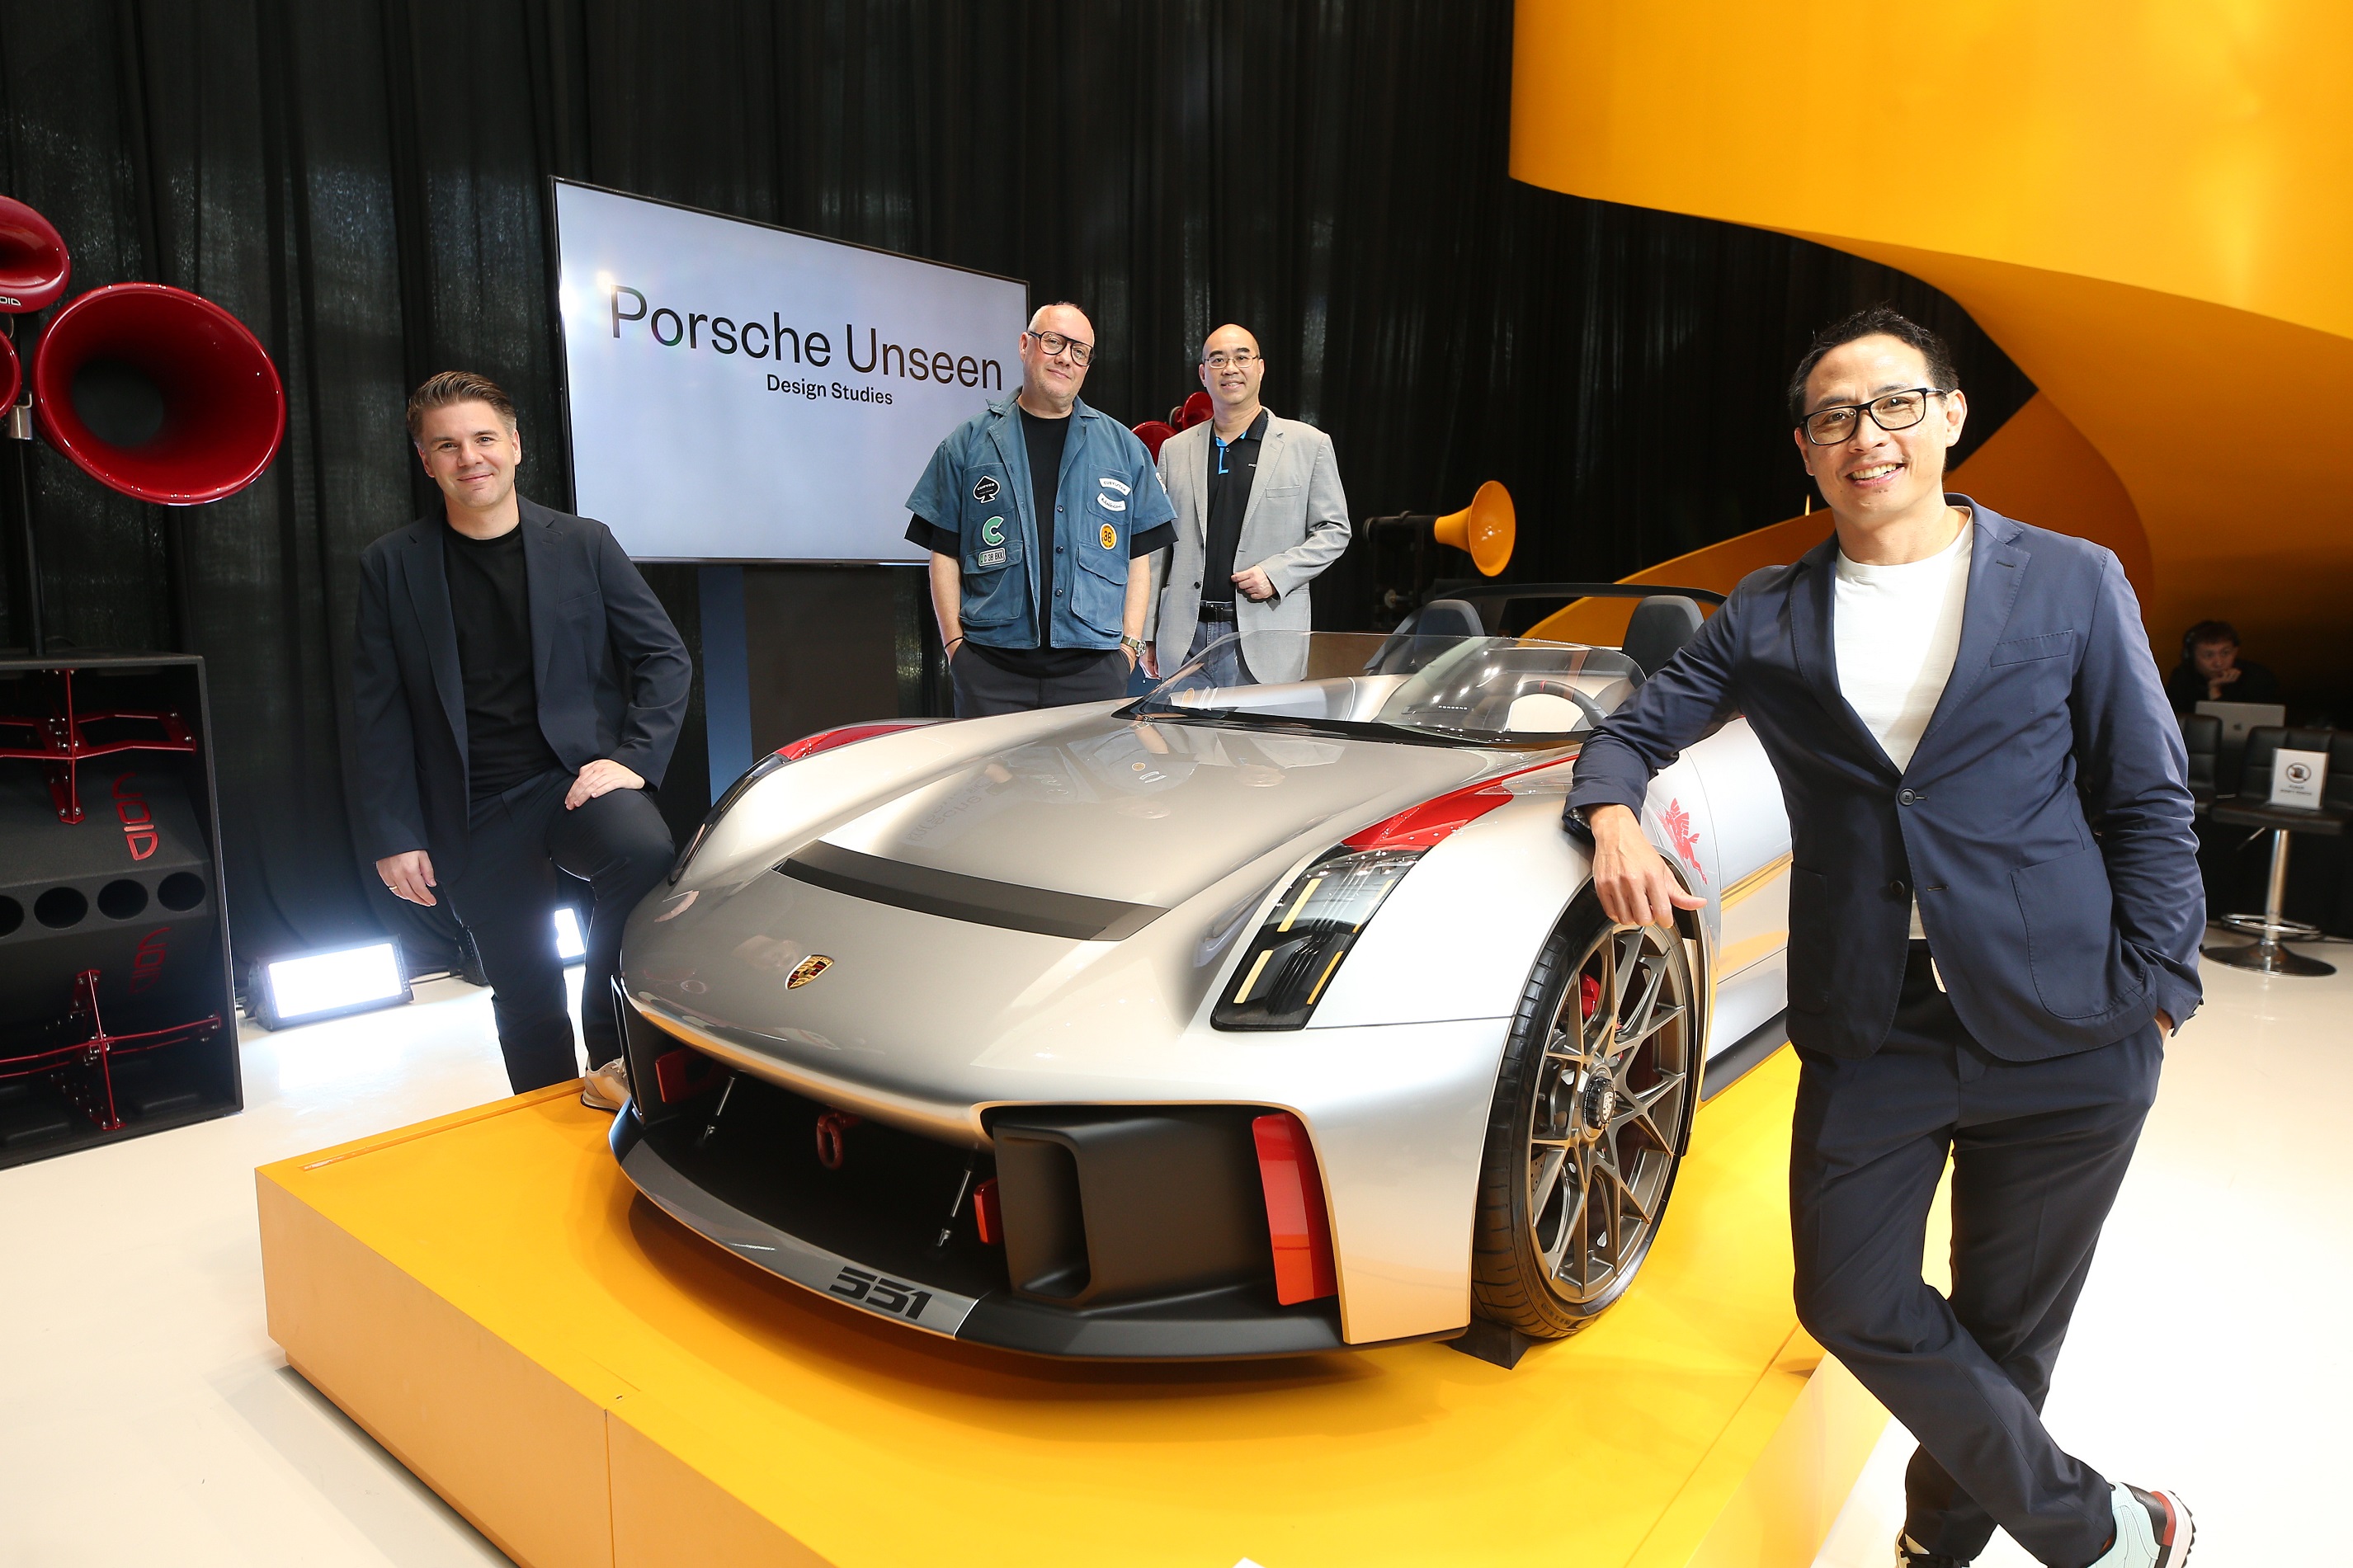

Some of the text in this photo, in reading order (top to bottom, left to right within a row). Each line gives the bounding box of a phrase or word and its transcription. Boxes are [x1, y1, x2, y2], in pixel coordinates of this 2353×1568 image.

[611, 285, 1003, 392] Porsche Unseen
[766, 374, 894, 406] Design Studies
[1104, 531, 1111, 543] 38
[828, 1265, 933, 1321] 551
